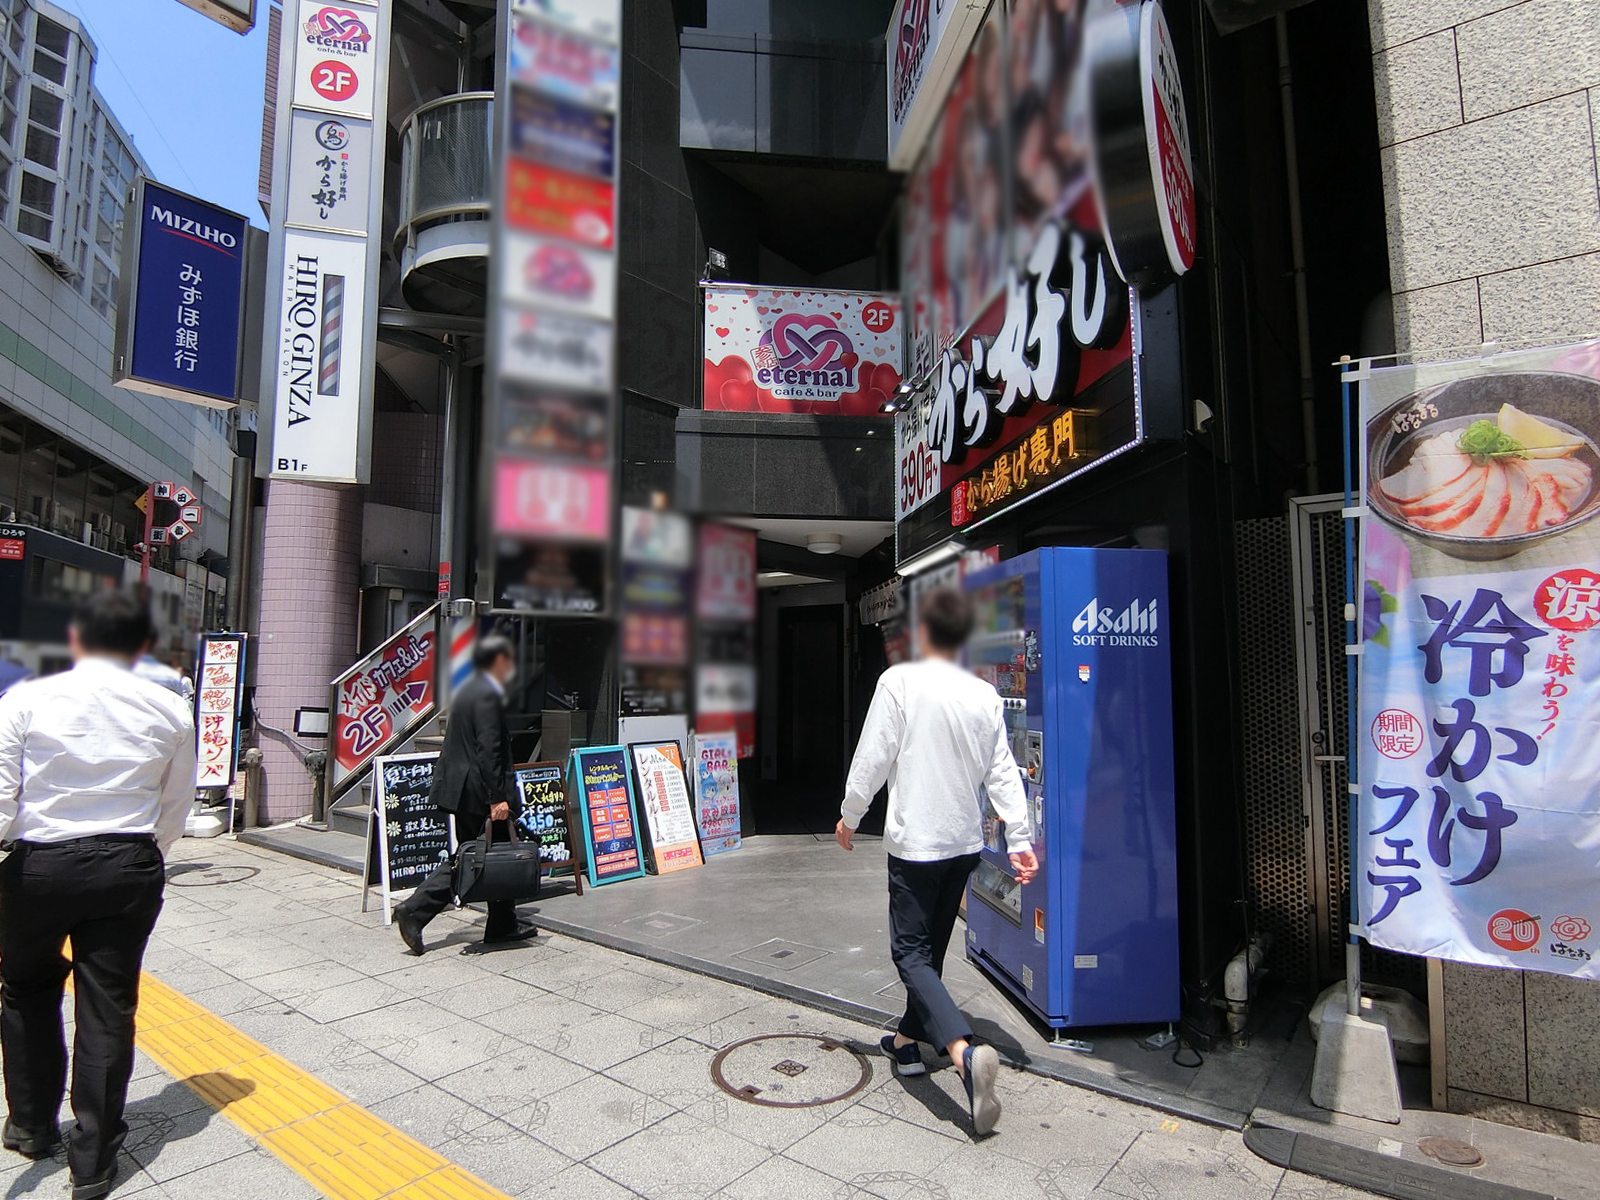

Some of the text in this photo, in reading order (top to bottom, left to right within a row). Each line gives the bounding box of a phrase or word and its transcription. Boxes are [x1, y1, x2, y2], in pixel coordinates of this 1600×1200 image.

[306, 34, 368, 53] eternal
[318, 68, 351, 92] 2F
[312, 155, 337, 220] から好し
[151, 205, 236, 248] MIZUHO
[174, 263, 202, 372] みずほ銀行
[867, 308, 890, 326] 2F
[282, 327, 291, 377] SALON
[928, 225, 1107, 463] から好し
[757, 367, 854, 387] eternal
[774, 387, 838, 398] cafe & bar
[1391, 401, 1439, 433] はなまる
[278, 458, 308, 472] B1F
[966, 409, 1075, 510] から揚げ専門
[0, 528, 26, 537] ひろや
[1072, 597, 1157, 633] Asahi
[1073, 635, 1158, 647] SOFT DRINKS
[343, 704, 386, 755] 2F
[1377, 714, 1413, 733] 期間
[1417, 588, 1549, 886] 冷かけ
[1379, 734, 1415, 753] 限定
[638, 753, 665, 842] レンタルルーム
[701, 803, 737, 819] 飲み放題
[1367, 784, 1422, 927] フェア
[1550, 942, 1592, 961] はなまる
